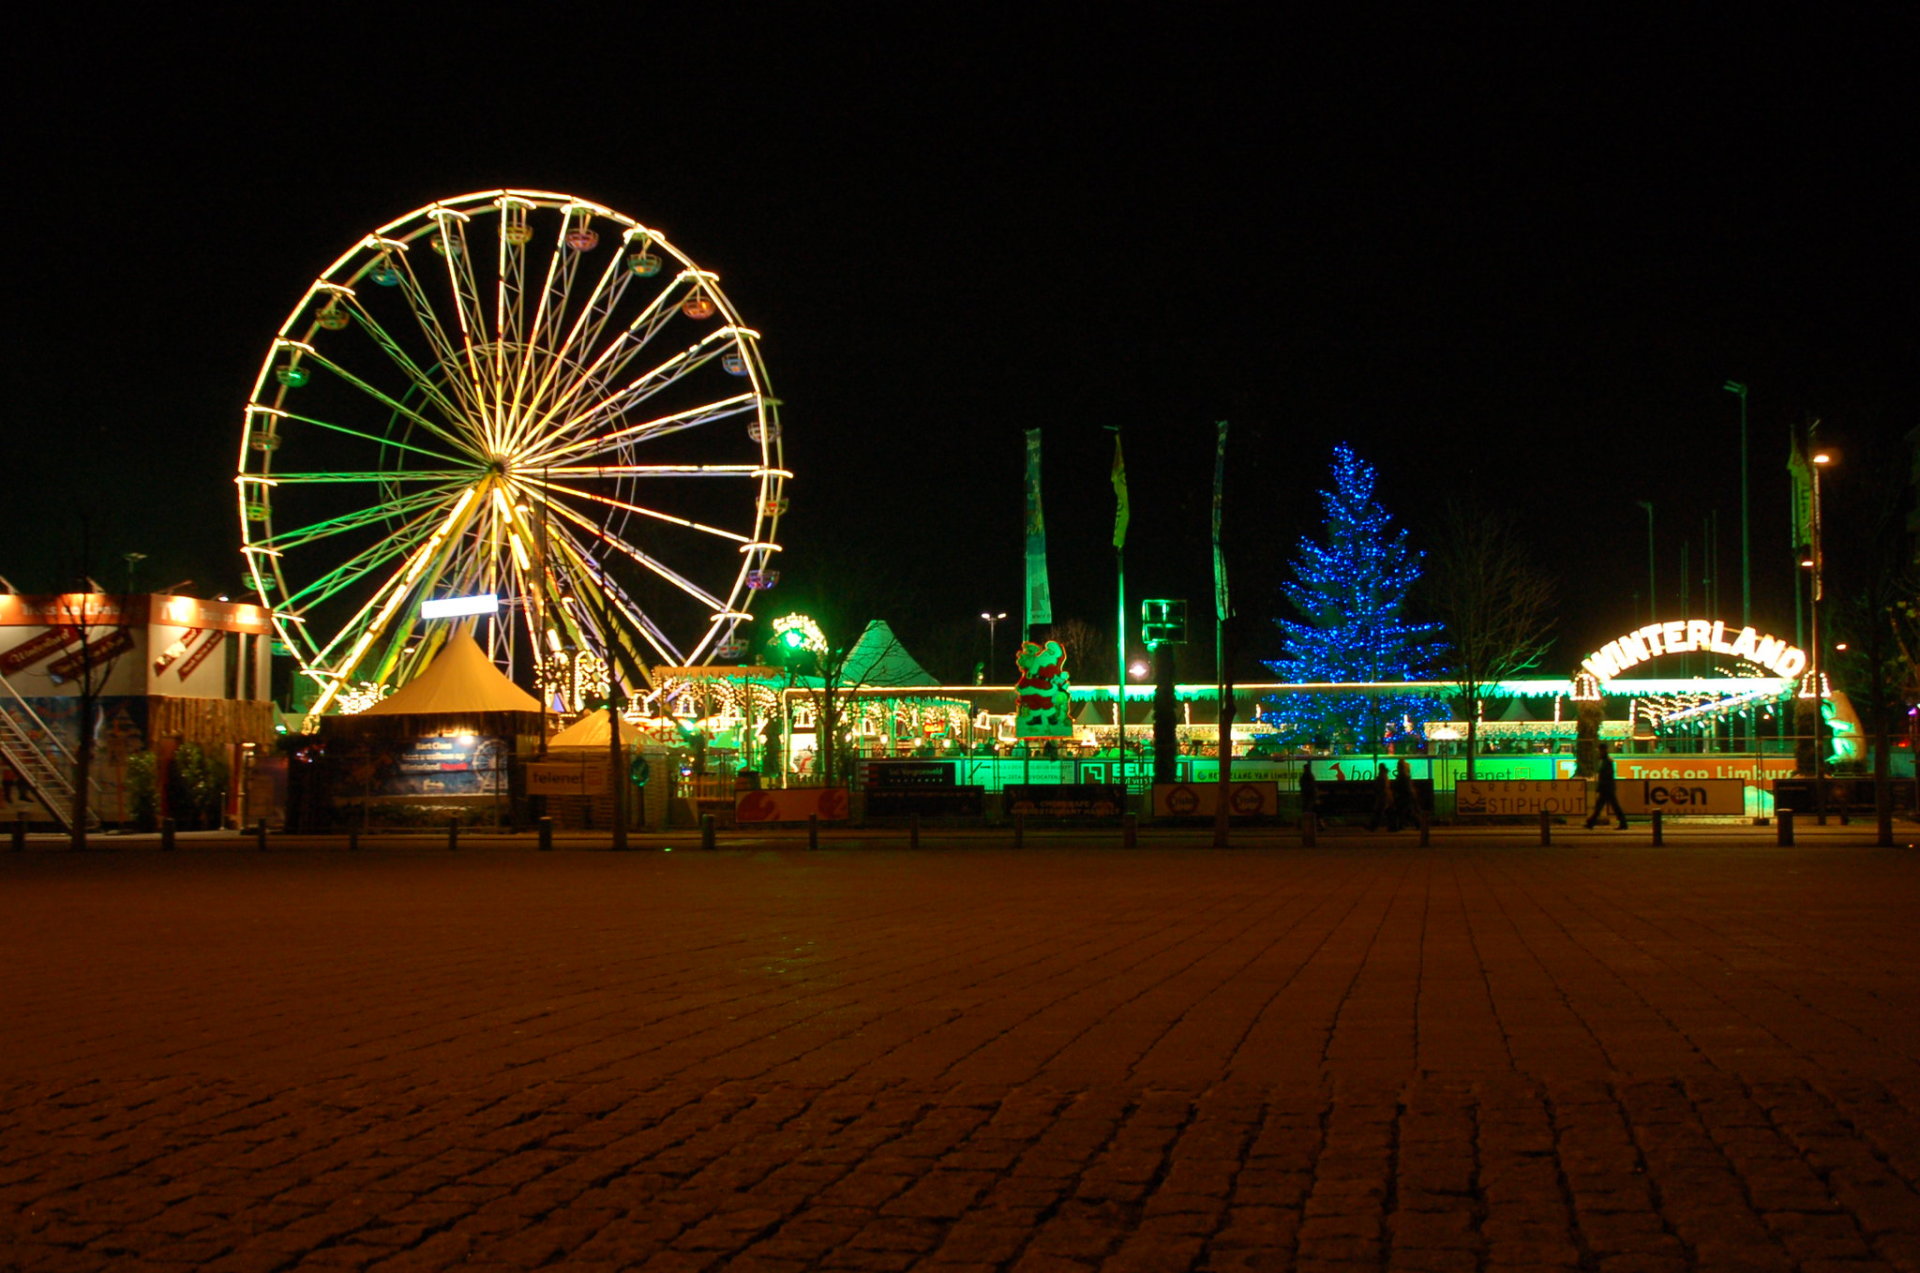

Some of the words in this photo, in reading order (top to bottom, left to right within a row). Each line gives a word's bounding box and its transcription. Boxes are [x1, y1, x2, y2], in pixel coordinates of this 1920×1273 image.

[1581, 620, 1806, 684] WINTERLAND
[1488, 783, 1585, 792] REDERIJ
[1488, 797, 1584, 814] STIPHOUT
